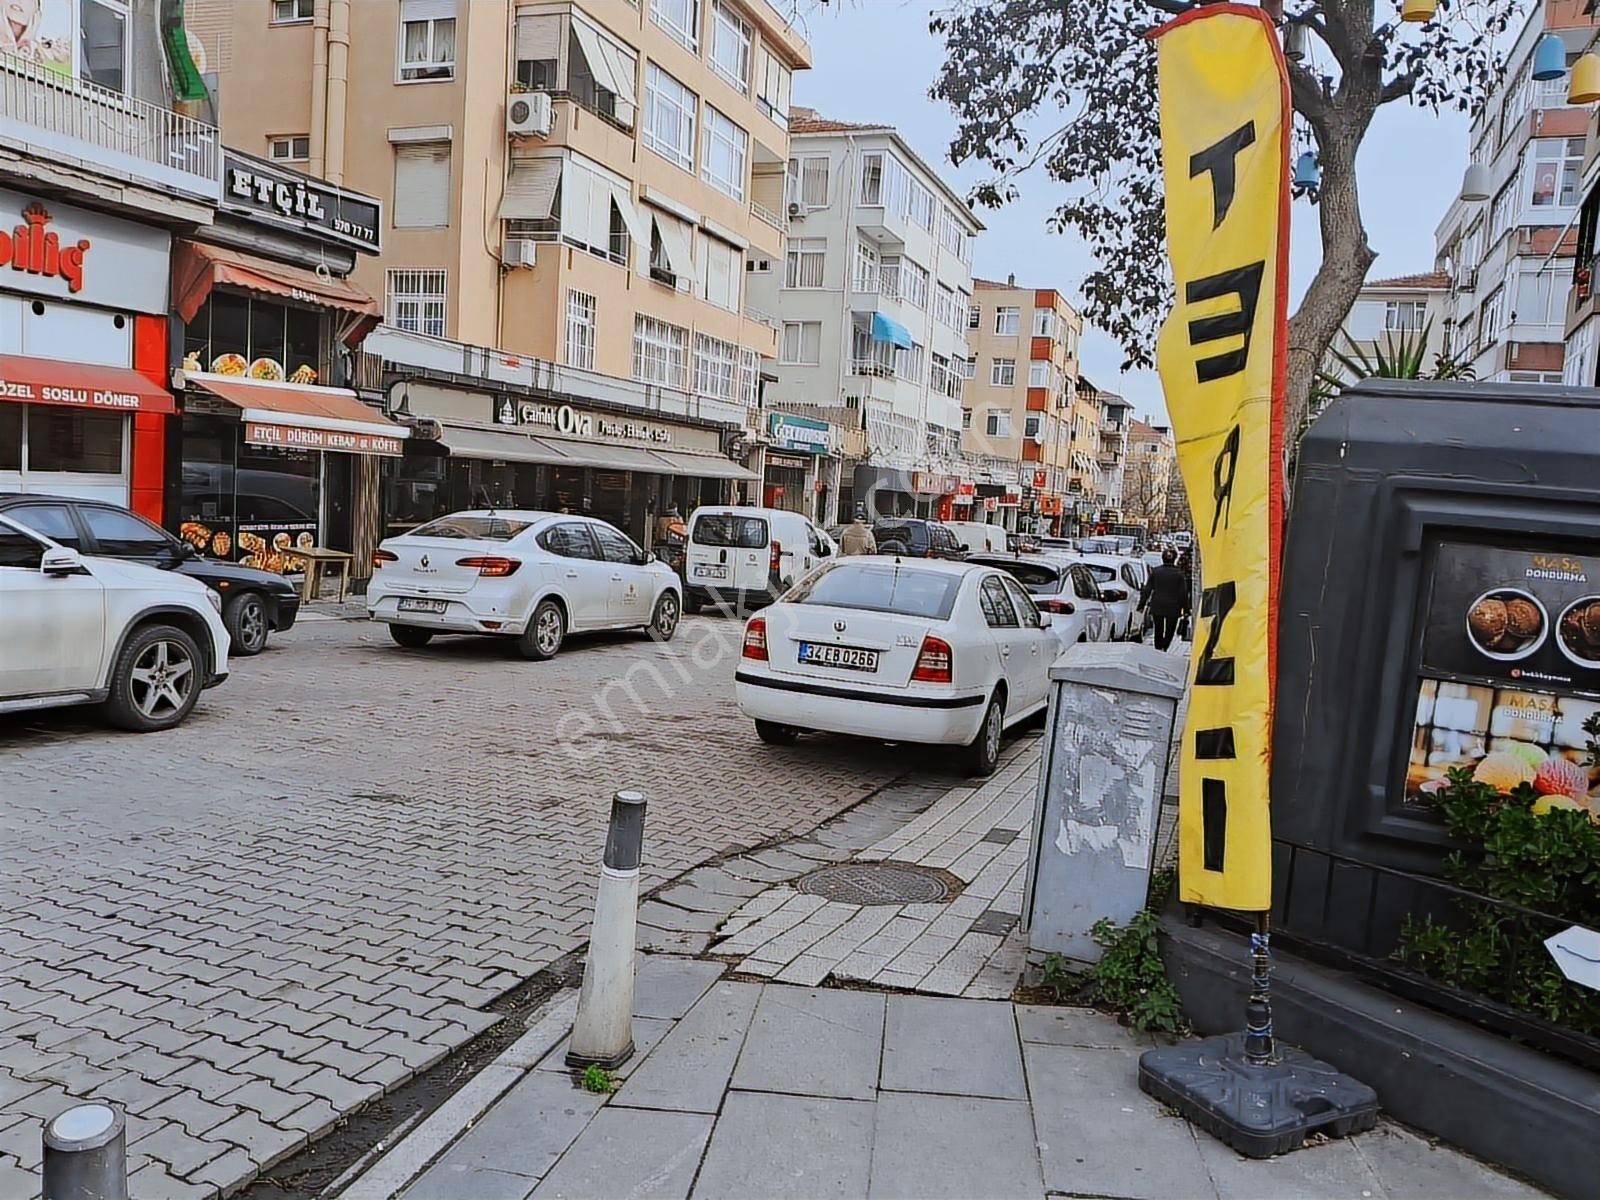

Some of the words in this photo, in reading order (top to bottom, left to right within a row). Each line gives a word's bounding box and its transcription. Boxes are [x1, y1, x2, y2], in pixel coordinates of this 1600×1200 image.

[232, 167, 325, 220] ETÇİL
[0, 380, 35, 399] ÖZEL
[42, 386, 87, 403] SOSLU
[94, 390, 140, 408] DÖNER
[557, 405, 593, 437] Ova
[254, 426, 281, 443] ETÇİL
[287, 428, 323, 445] DÜRÜM
[328, 433, 356, 448] KEBAP
[372, 438, 399, 452] KÖFTE
[1525, 568, 1587, 583] DONDURMA
[1532, 555, 1584, 572] MASA
[807, 645, 821, 660] 34
[843, 650, 875, 666] 0266
